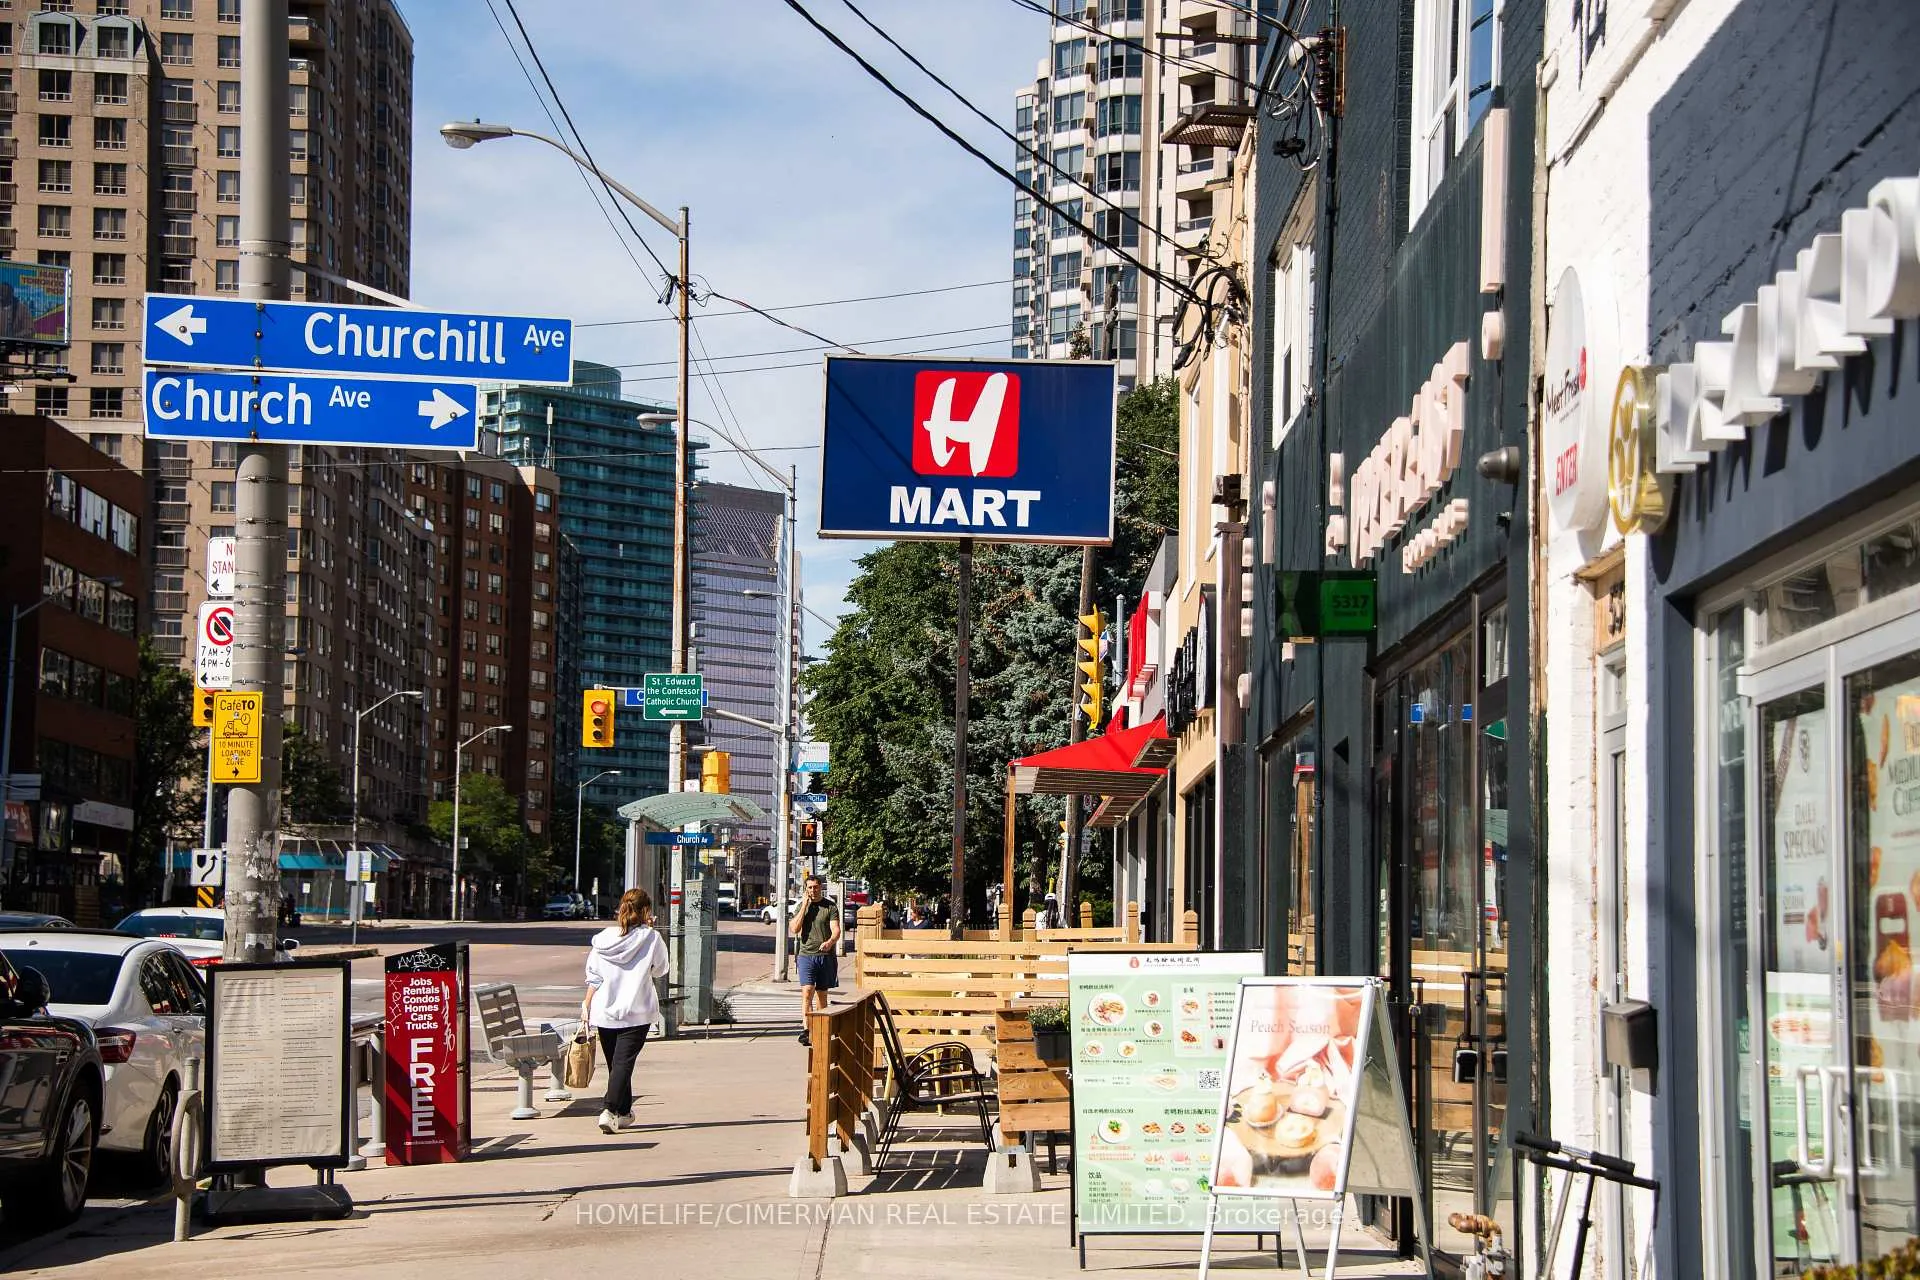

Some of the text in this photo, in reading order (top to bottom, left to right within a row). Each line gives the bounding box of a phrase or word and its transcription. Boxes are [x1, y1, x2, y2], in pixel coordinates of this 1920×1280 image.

[304, 311, 565, 365] Churchill Ave
[153, 377, 371, 425] Church Ave
[923, 372, 1008, 478] H
[1555, 442, 1578, 497] ENTER
[889, 485, 1041, 528] MART
[226, 543, 236, 556] N
[212, 560, 234, 574] STAN
[1332, 594, 1370, 609] 5317
[201, 645, 207, 656] 7
[208, 647, 218, 656] AM
[225, 645, 232, 656] 9
[200, 657, 206, 668] 4
[207, 658, 218, 668] PM
[225, 657, 231, 668] 6
[651, 677, 696, 686] St. Edward
[647, 687, 700, 695] the Confessor
[646, 697, 701, 706] Catholic Church
[227, 740, 254, 749] MINUTE
[676, 834, 700, 844] Church
[410, 977, 433, 986] Jobs
[403, 986, 440, 995] Rentals
[403, 995, 441, 1004] Condos
[404, 1004, 439, 1013] Homes
[411, 1013, 433, 1021] Cars
[405, 1021, 438, 1031] Trucks
[1250, 1019, 1331, 1036] Peach Season
[409, 1037, 436, 1137] FREE
